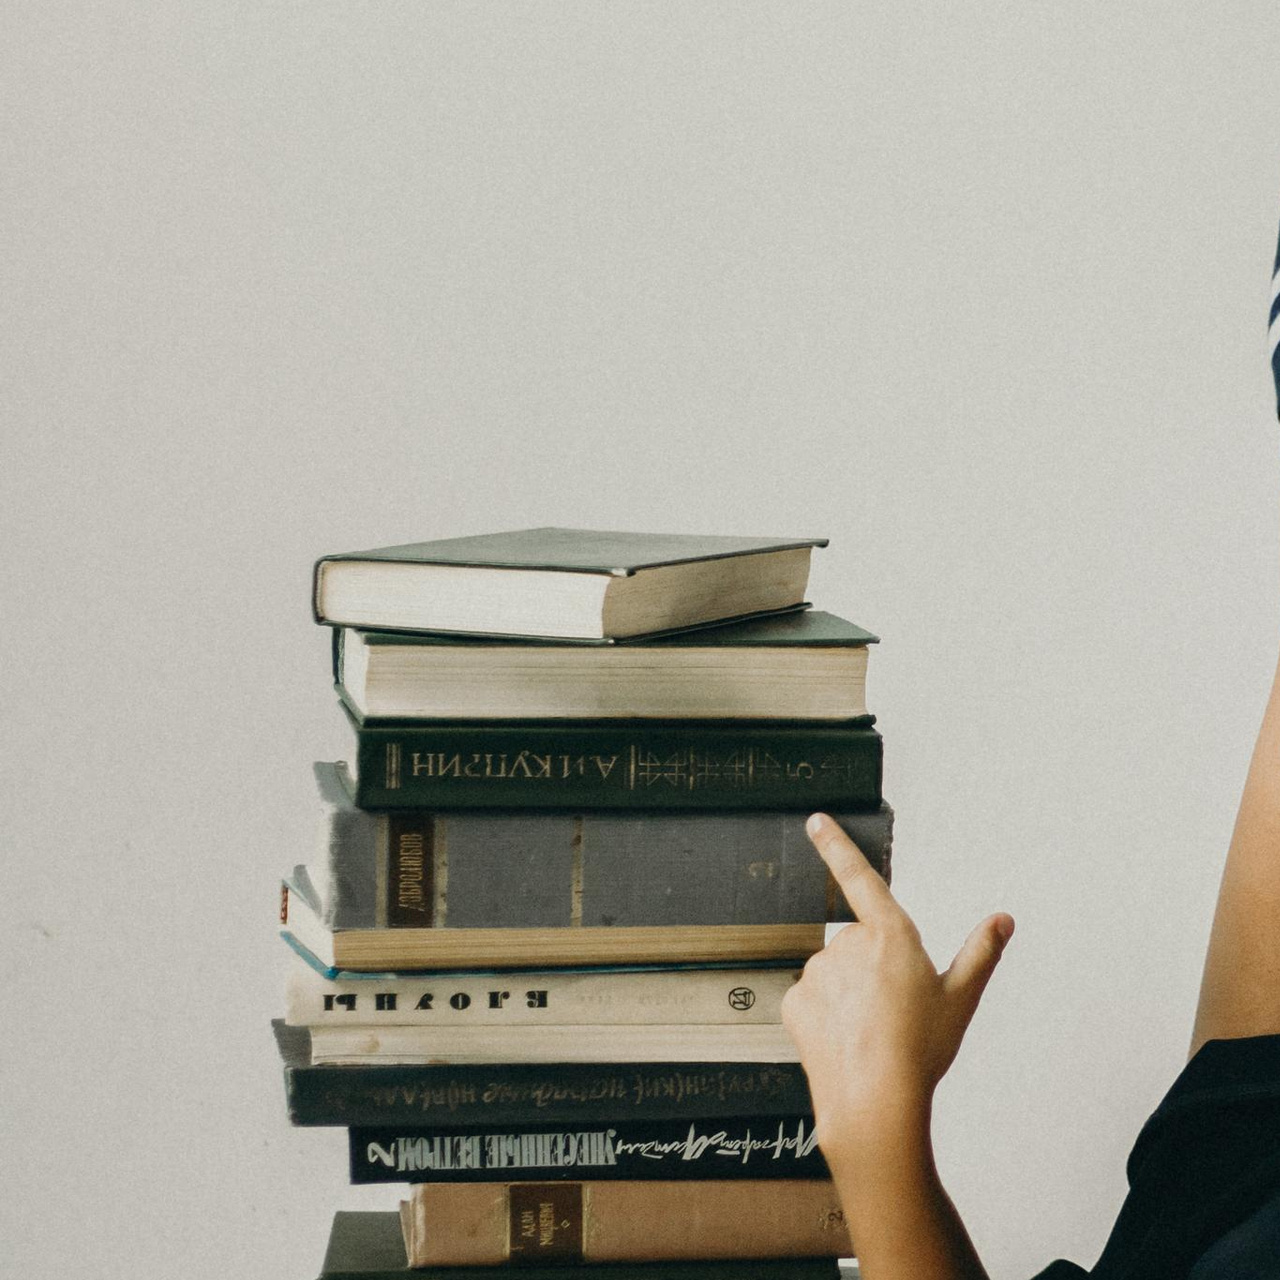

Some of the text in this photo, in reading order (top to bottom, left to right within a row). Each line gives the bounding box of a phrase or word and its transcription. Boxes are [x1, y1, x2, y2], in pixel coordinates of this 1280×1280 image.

[785, 761, 815, 780] 5
[321, 989, 548, 1012] КЛОУНЫ
[367, 1141, 395, 1164] 2
[394, 1134, 481, 1171] ВЕТРОМ
[486, 1129, 617, 1167] УНЕСЕННЫЕ
